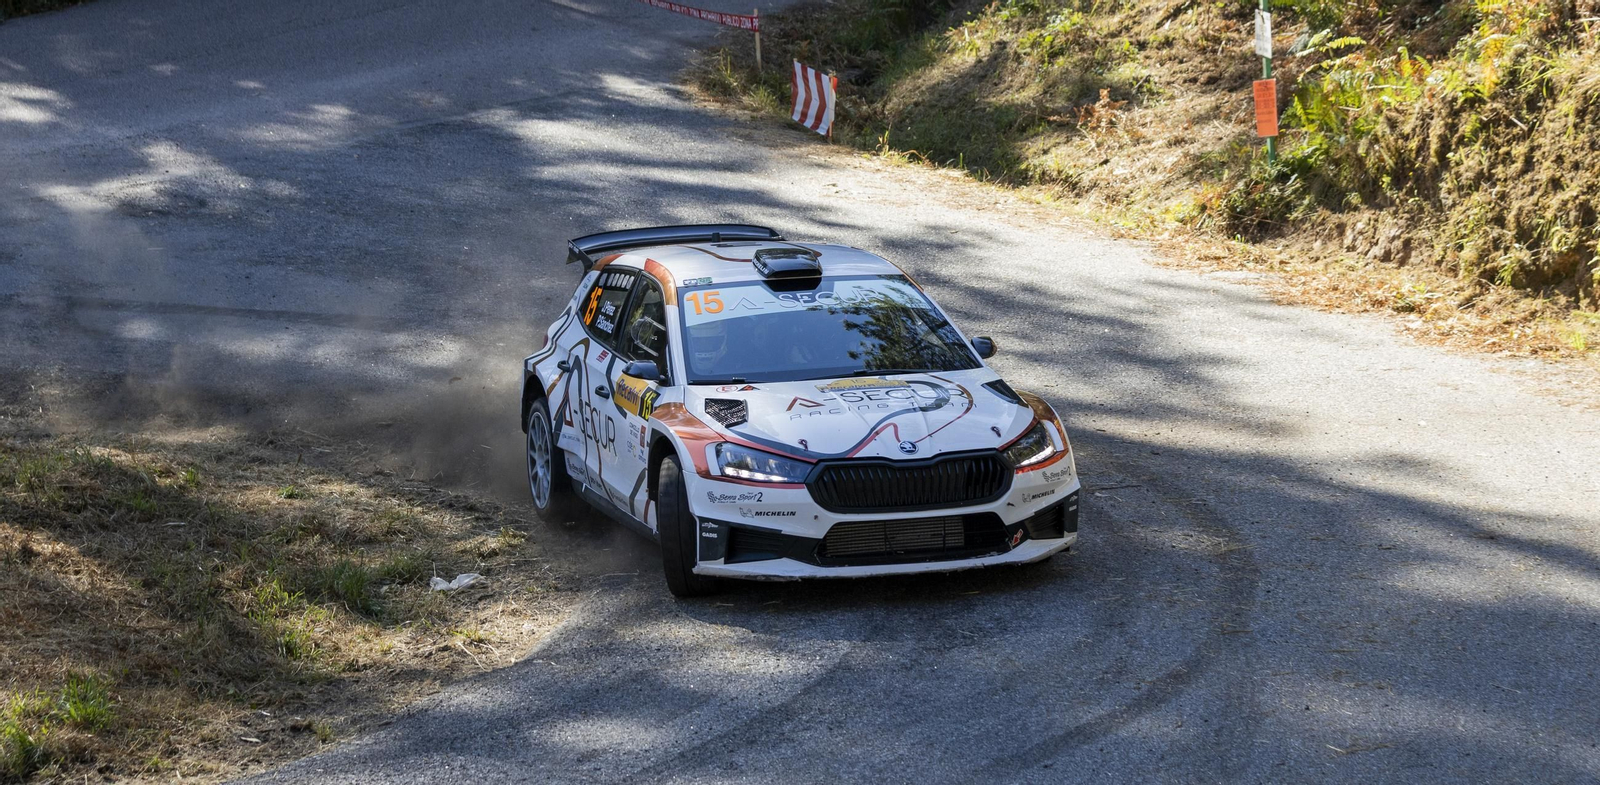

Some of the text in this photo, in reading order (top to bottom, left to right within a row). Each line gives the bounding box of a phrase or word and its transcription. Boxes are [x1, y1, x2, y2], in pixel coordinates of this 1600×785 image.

[584, 286, 603, 326] 15
[686, 291, 725, 315] 15
[642, 391, 657, 420] 15
[756, 492, 763, 502] 2
[1032, 490, 1055, 499] MICHELIN
